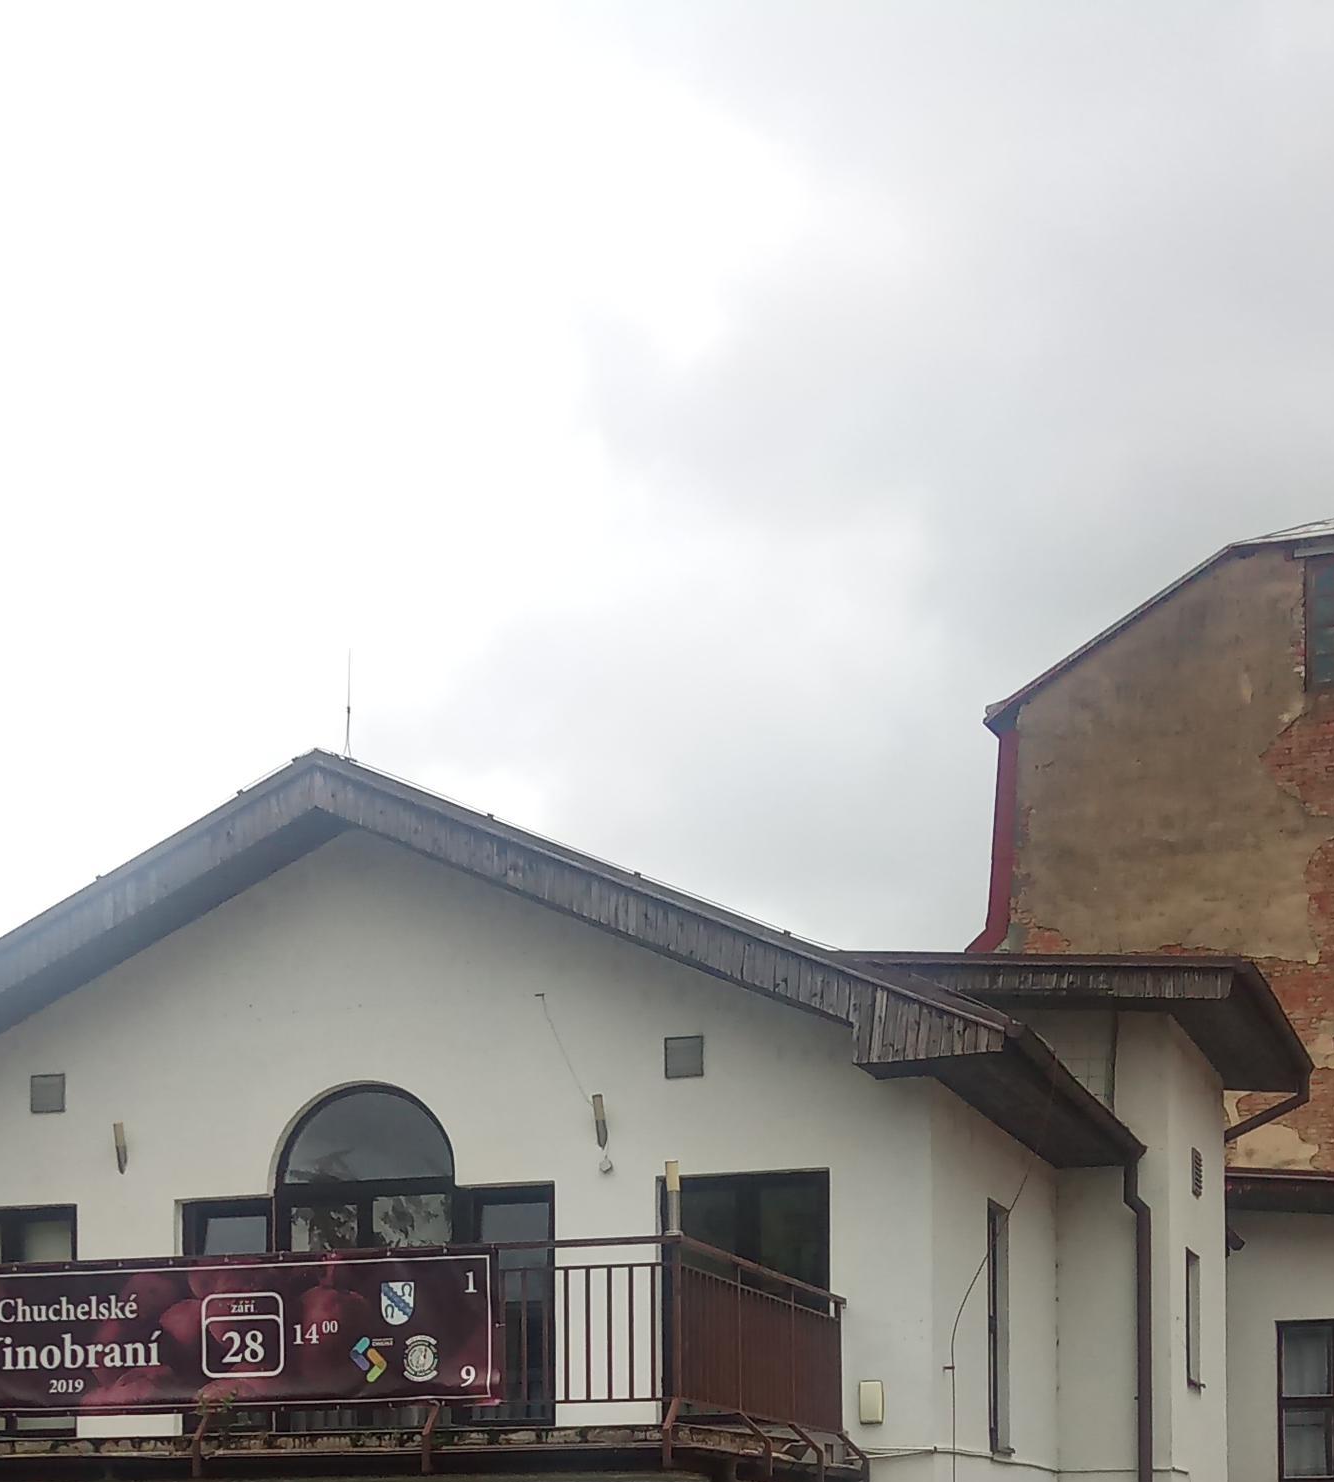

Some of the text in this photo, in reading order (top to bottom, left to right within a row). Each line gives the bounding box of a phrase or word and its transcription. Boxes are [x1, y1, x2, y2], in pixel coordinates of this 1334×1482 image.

[464, 1271, 478, 1293] 1
[230, 1300, 256, 1313] září
[221, 1330, 265, 1363] 28
[49, 1379, 85, 1394] 2019
[460, 1366, 476, 1387] 9
